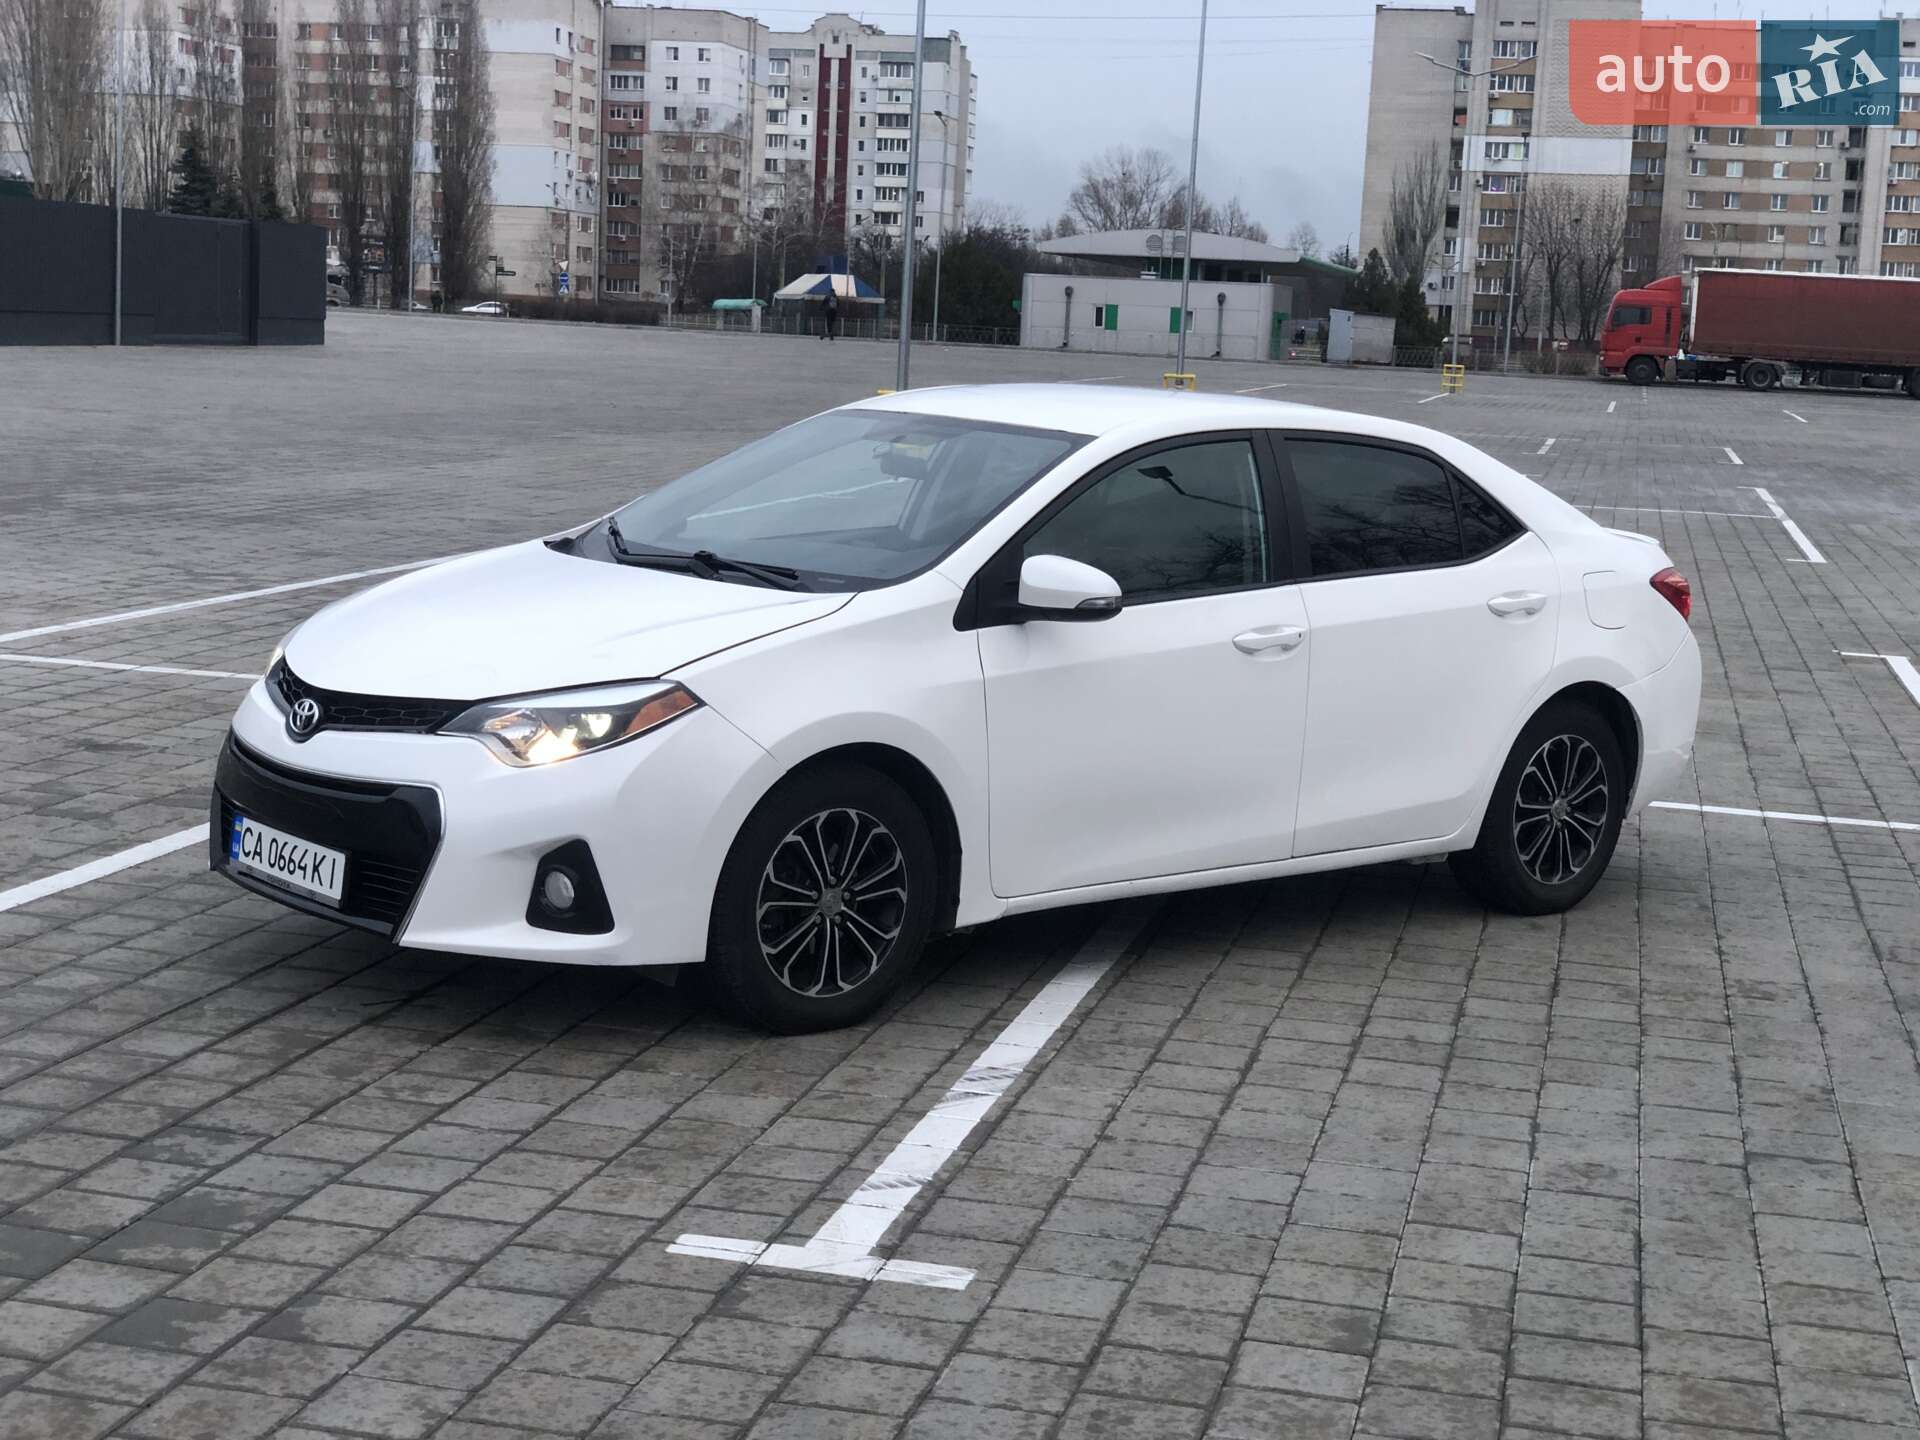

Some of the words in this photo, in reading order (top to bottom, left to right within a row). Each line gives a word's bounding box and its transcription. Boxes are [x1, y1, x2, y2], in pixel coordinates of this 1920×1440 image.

[242, 826, 263, 864] CA
[268, 837, 309, 881] 0664
[311, 851, 336, 890] KI
